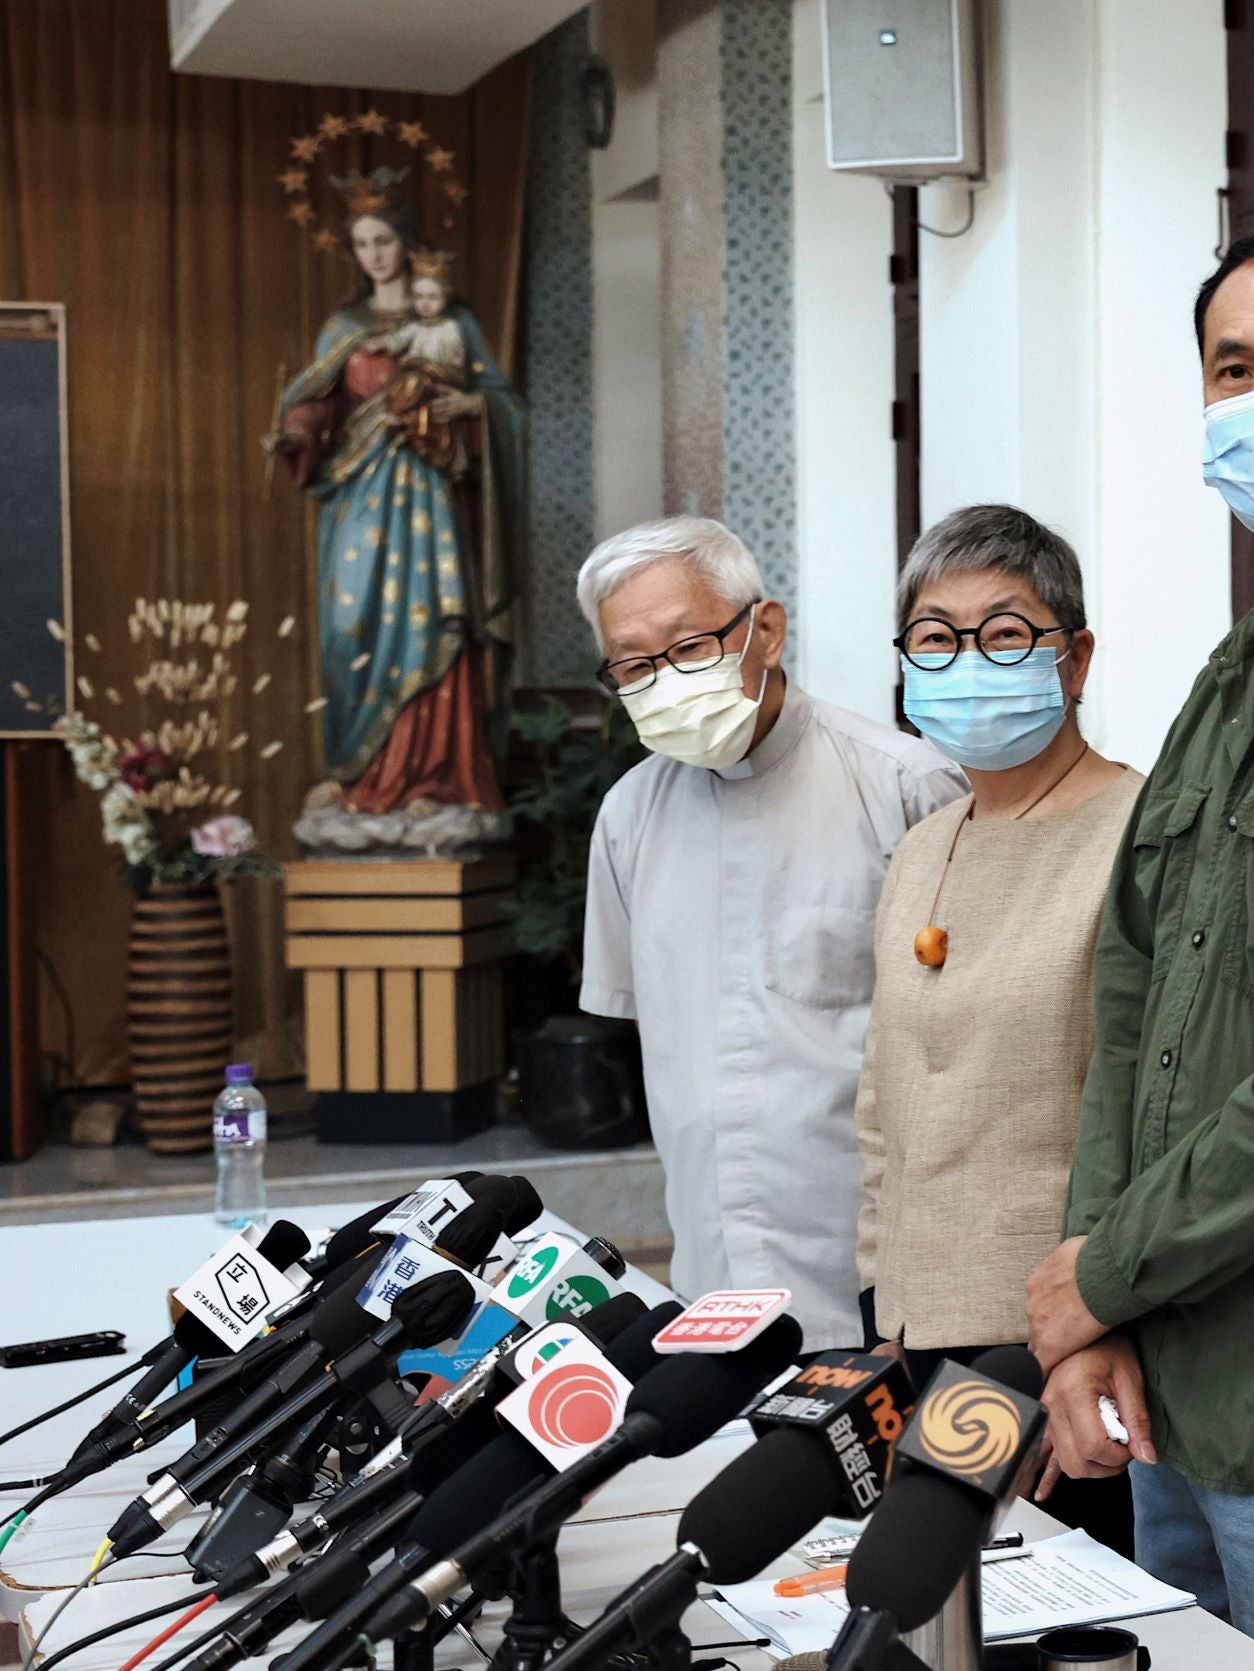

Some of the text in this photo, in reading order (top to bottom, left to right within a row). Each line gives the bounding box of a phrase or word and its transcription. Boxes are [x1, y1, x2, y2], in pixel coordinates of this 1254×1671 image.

[192, 1290, 242, 1335] STANDNEWS
[226, 1262, 259, 1316] 立場
[697, 1300, 773, 1313] RTHK
[795, 1364, 874, 1389] now
[864, 1383, 904, 1482] no
[826, 1413, 881, 1508] 財經台
